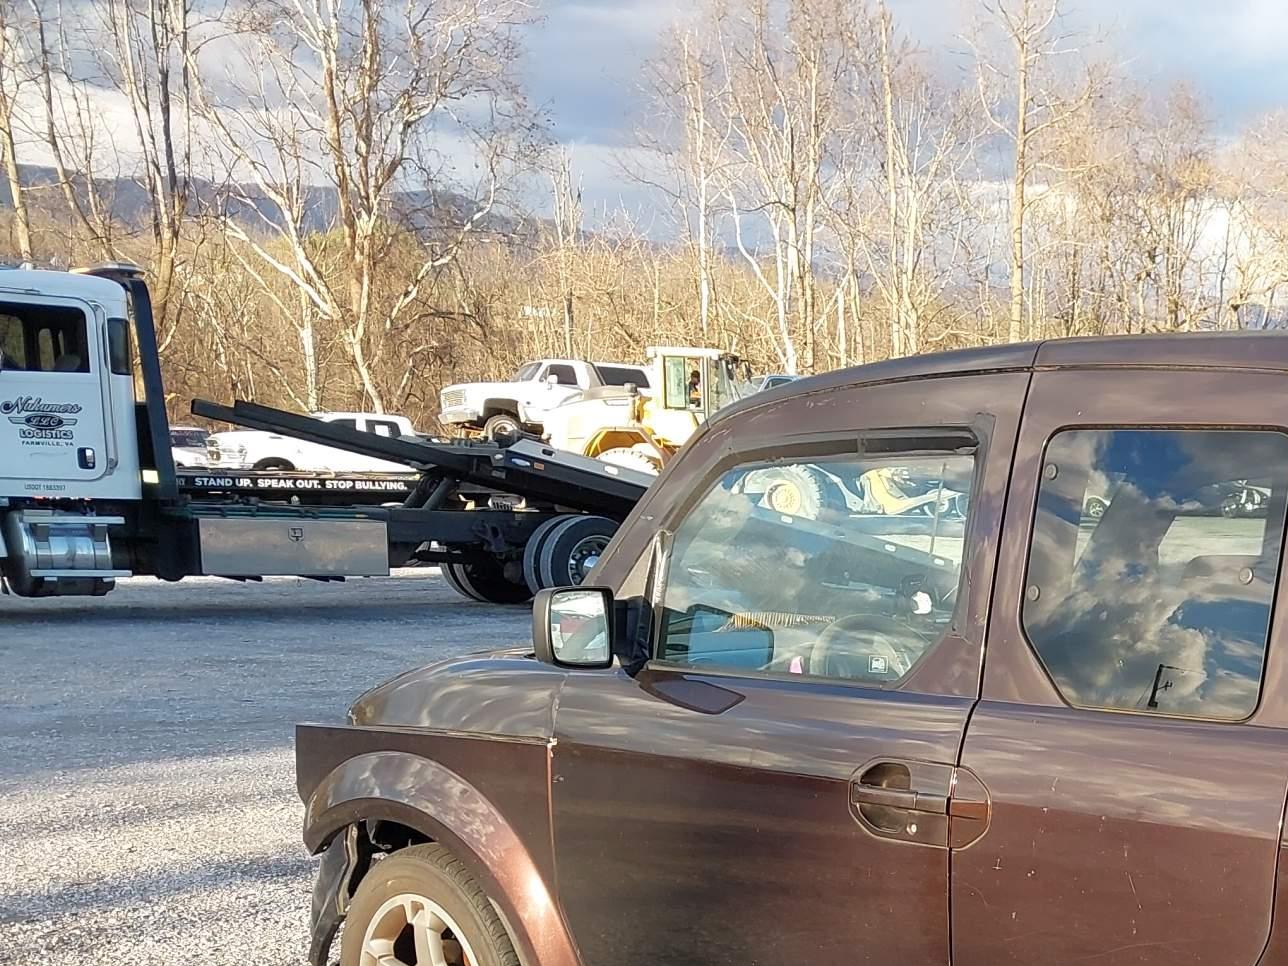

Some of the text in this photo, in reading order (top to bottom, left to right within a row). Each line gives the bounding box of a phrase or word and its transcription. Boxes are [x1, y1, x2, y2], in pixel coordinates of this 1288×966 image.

[30, 415, 59, 426] LLC
[20, 429, 73, 439] LOGISTICS
[194, 477, 233, 488] STAND
[238, 478, 253, 488] UP.
[258, 478, 293, 488] SPEAK
[295, 478, 321, 488] OUT.
[326, 479, 353, 489] STOP
[355, 480, 407, 491] BULLYING.
